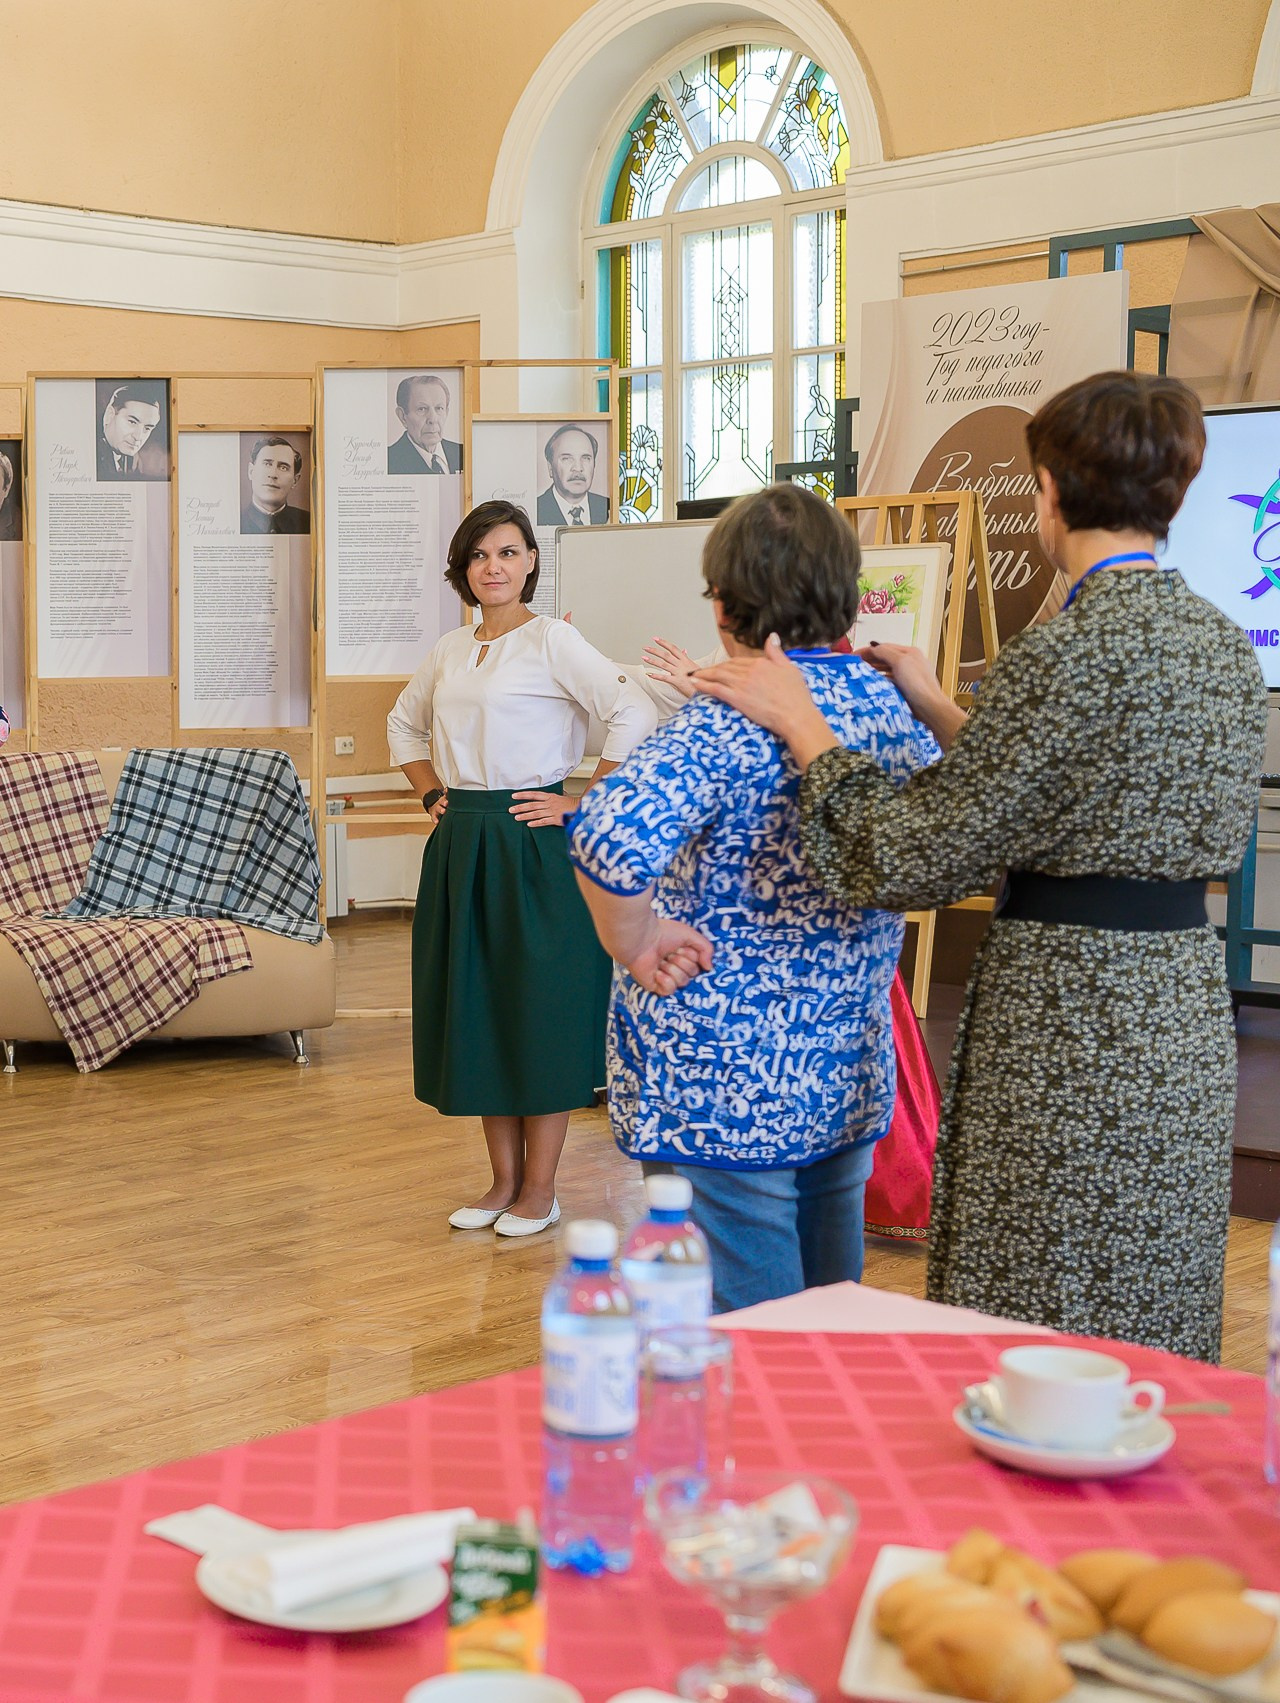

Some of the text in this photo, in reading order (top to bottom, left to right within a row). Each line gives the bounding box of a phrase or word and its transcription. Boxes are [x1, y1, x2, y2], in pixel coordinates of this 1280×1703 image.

[926, 348, 1043, 386] Год педагога
[926, 371, 1042, 404] и наставника
[927, 451, 1040, 512] Выбрат
